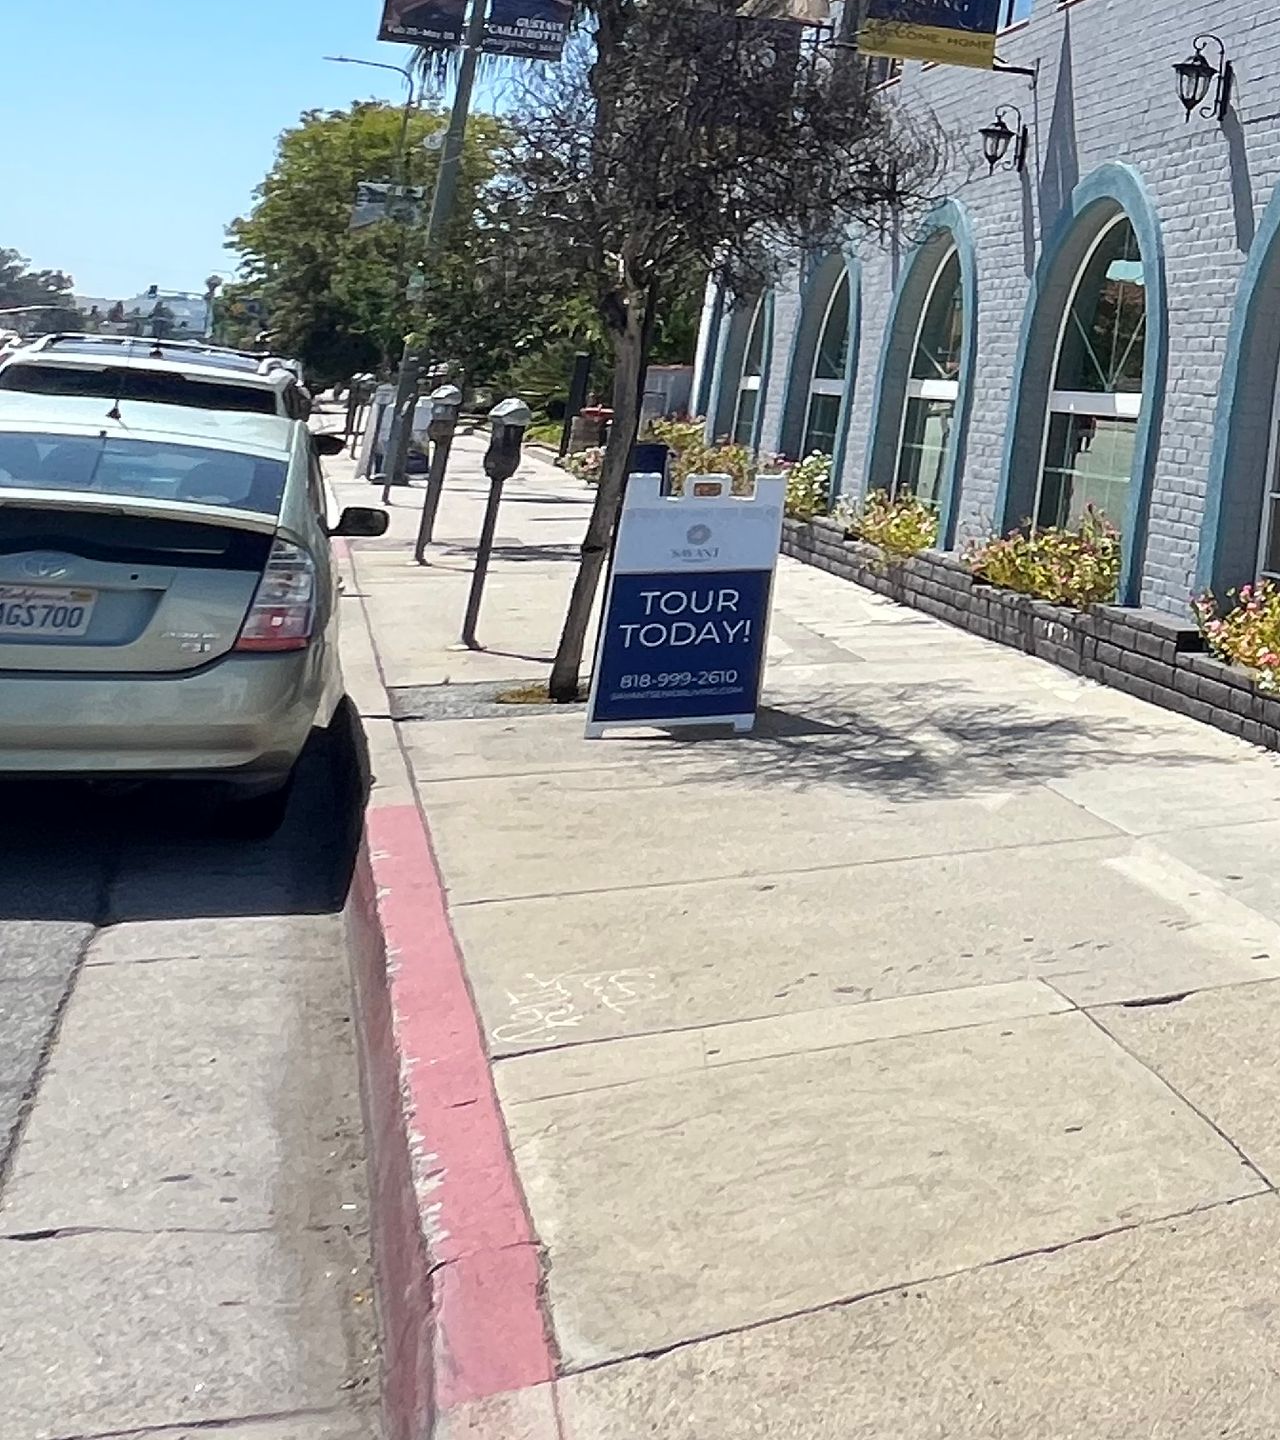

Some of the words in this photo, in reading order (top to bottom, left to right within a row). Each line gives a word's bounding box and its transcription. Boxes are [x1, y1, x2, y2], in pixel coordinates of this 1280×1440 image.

[946, 36, 993, 50] HOME
[639, 588, 740, 615] TOUR
[618, 618, 752, 649] TODAY!
[619, 668, 738, 689] 818-999-2610
